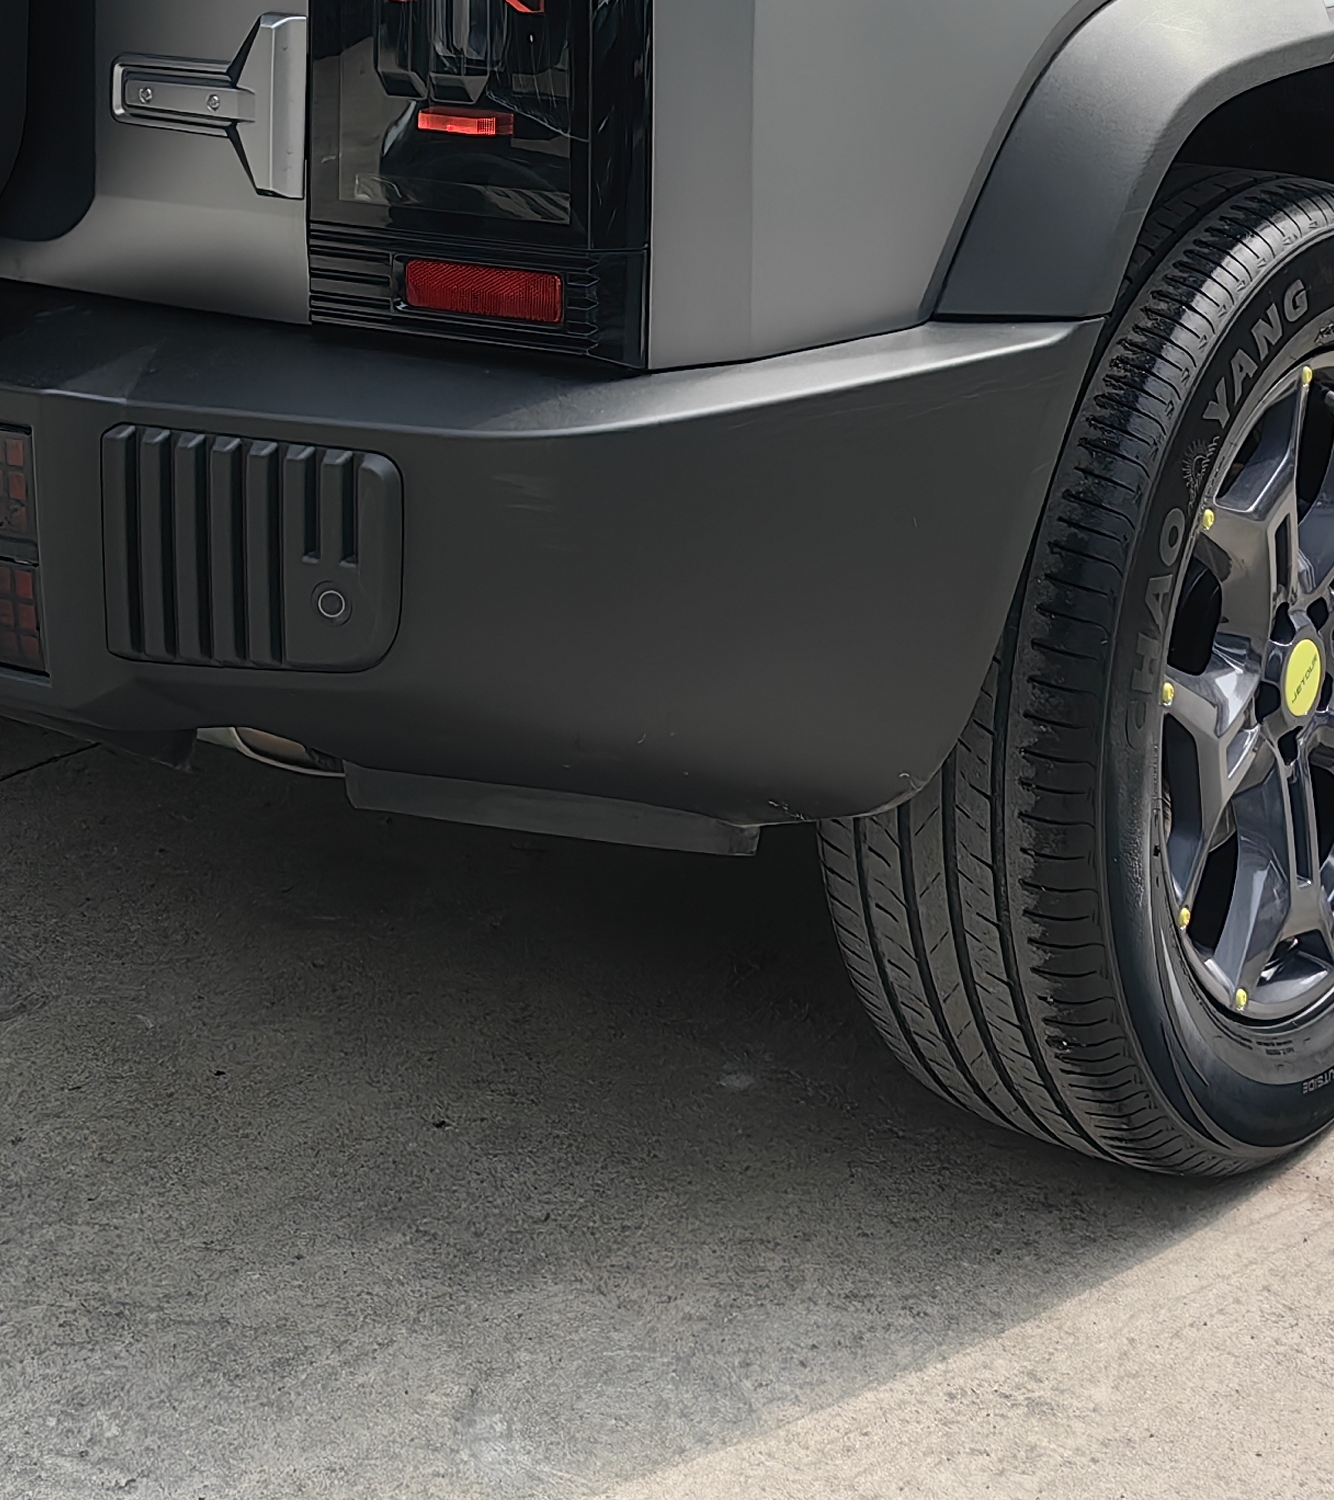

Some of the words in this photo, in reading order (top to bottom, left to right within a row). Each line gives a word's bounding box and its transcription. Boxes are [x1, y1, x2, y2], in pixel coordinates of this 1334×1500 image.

[1202, 278, 1309, 429] YANG
[1124, 506, 1187, 752] CHAO
[1291, 652, 1318, 705] JETOUR
